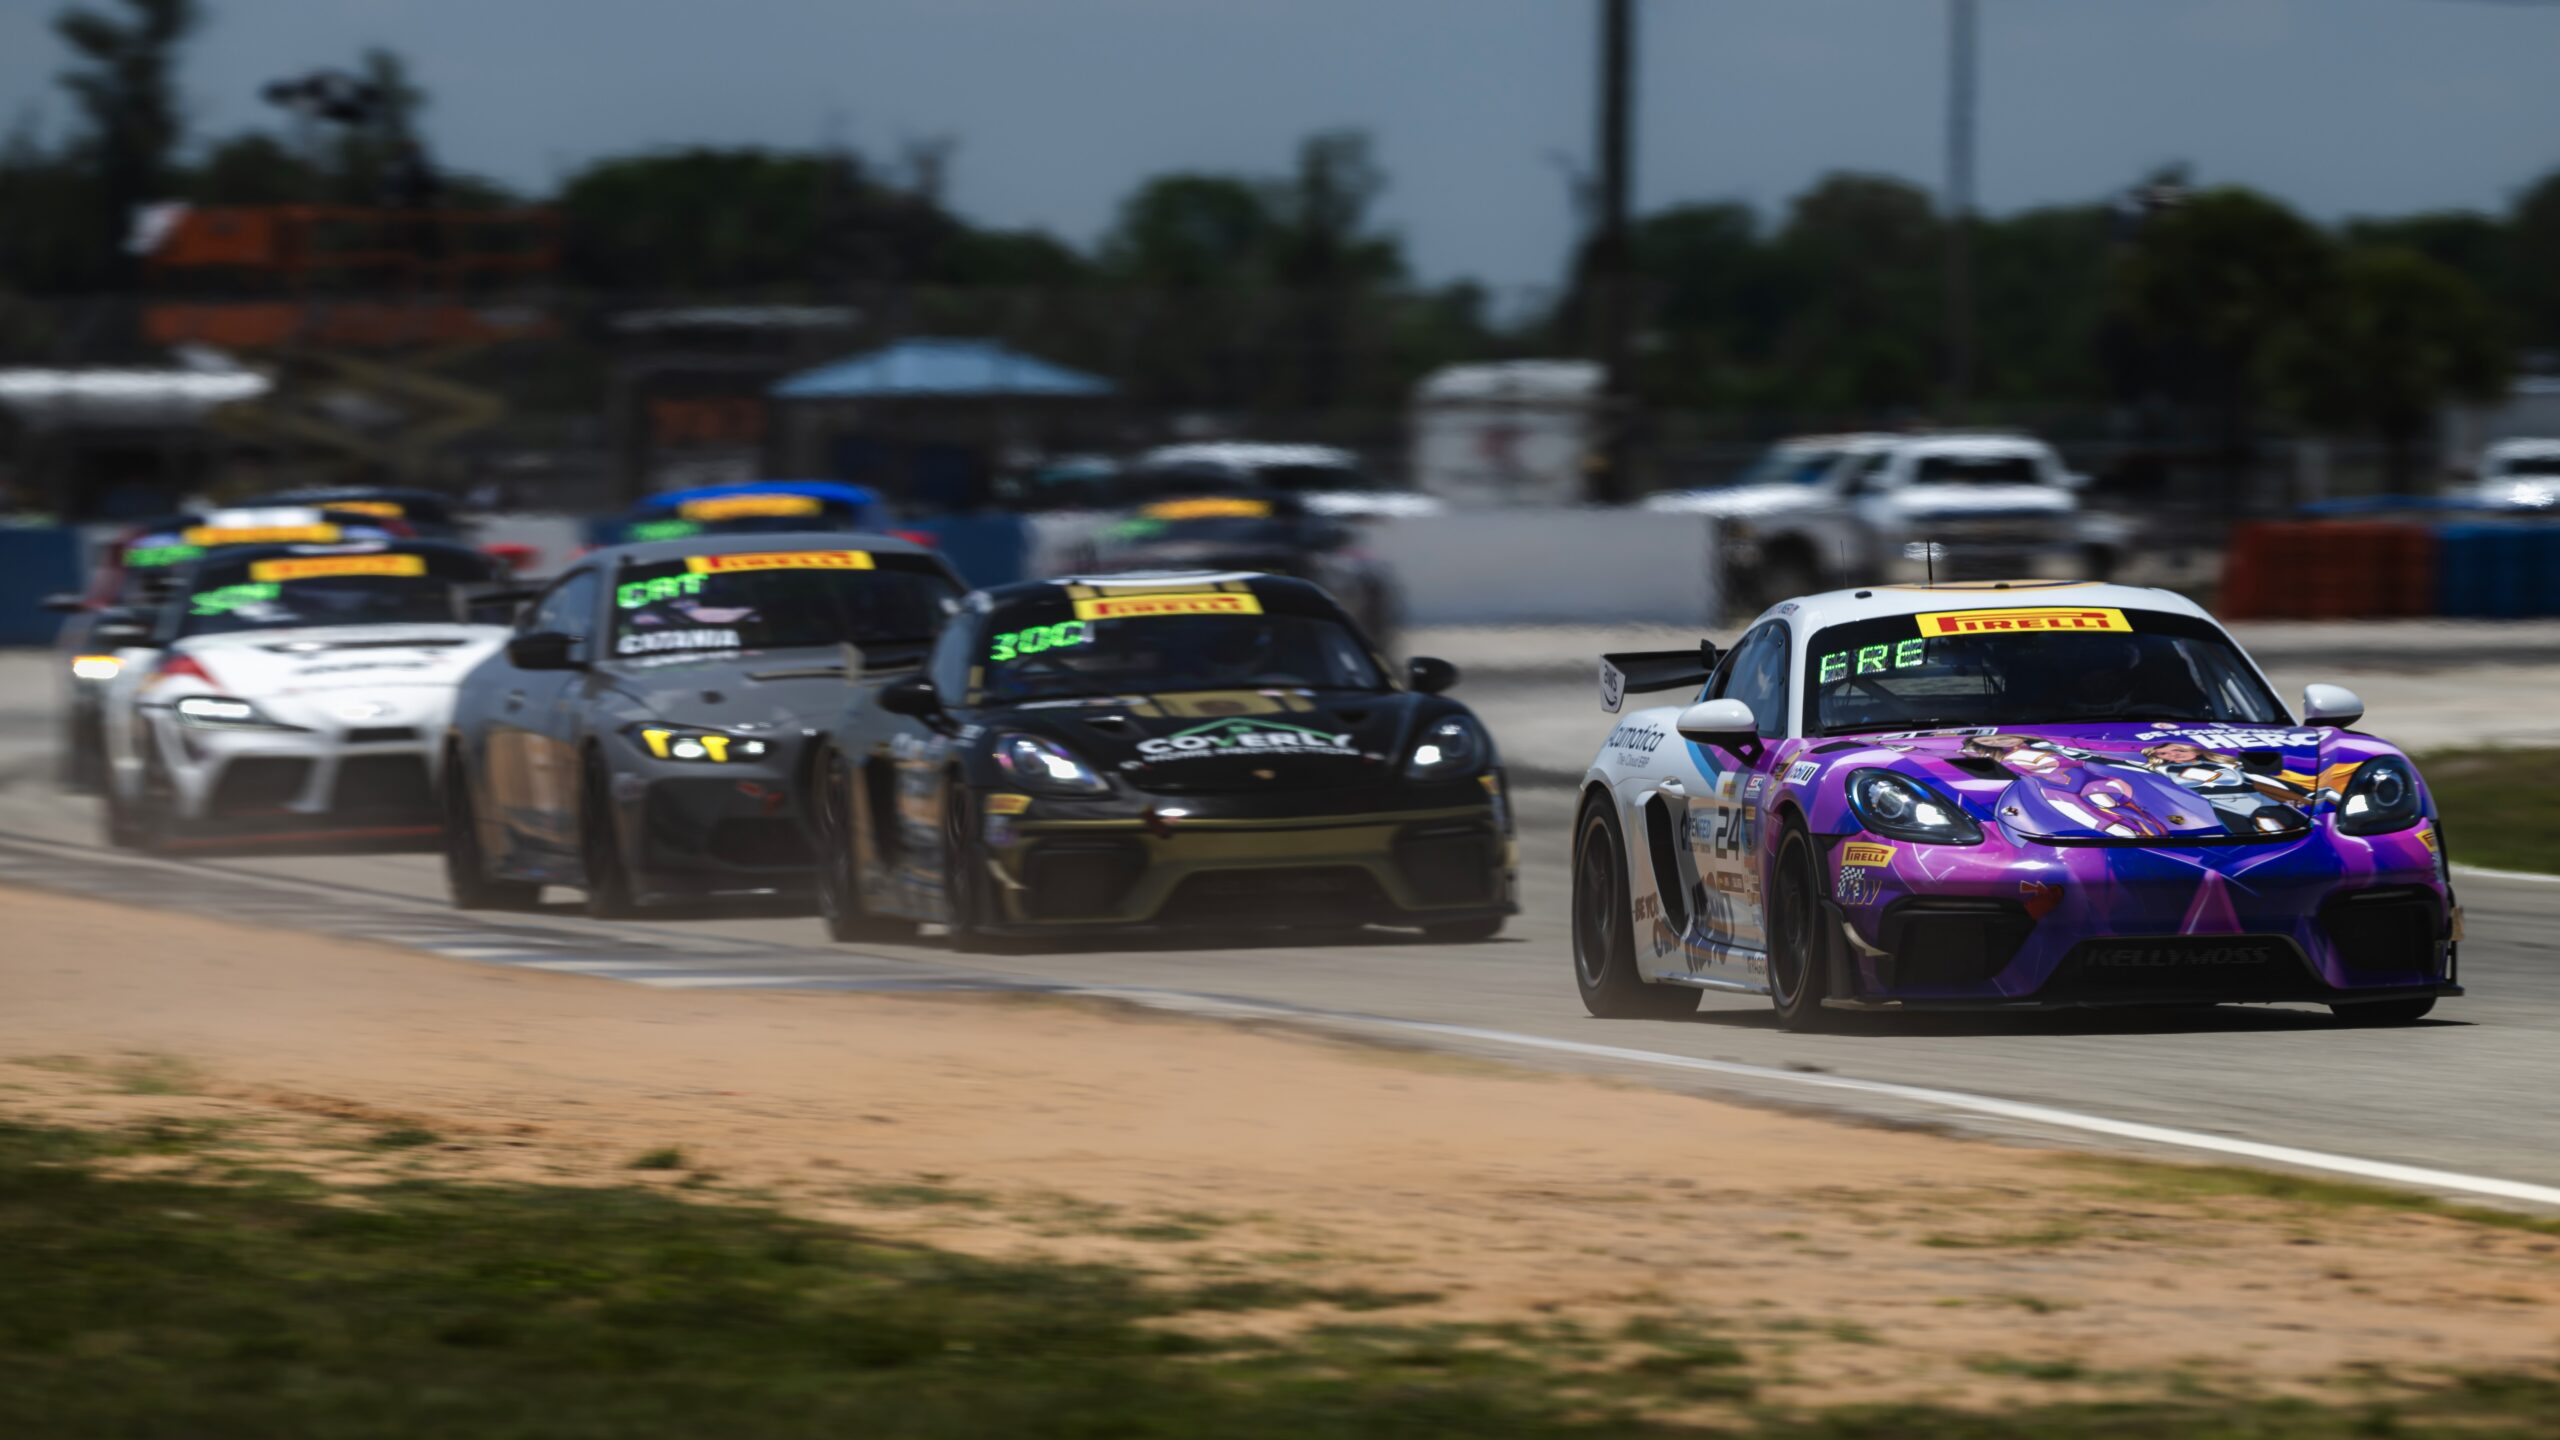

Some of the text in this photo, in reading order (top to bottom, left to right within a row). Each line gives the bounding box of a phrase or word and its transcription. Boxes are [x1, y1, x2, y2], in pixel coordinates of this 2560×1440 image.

[1936, 611, 2112, 633] PIRELLI
[1715, 805, 1742, 860] 24
[1845, 846, 1889, 862] PIRELLI
